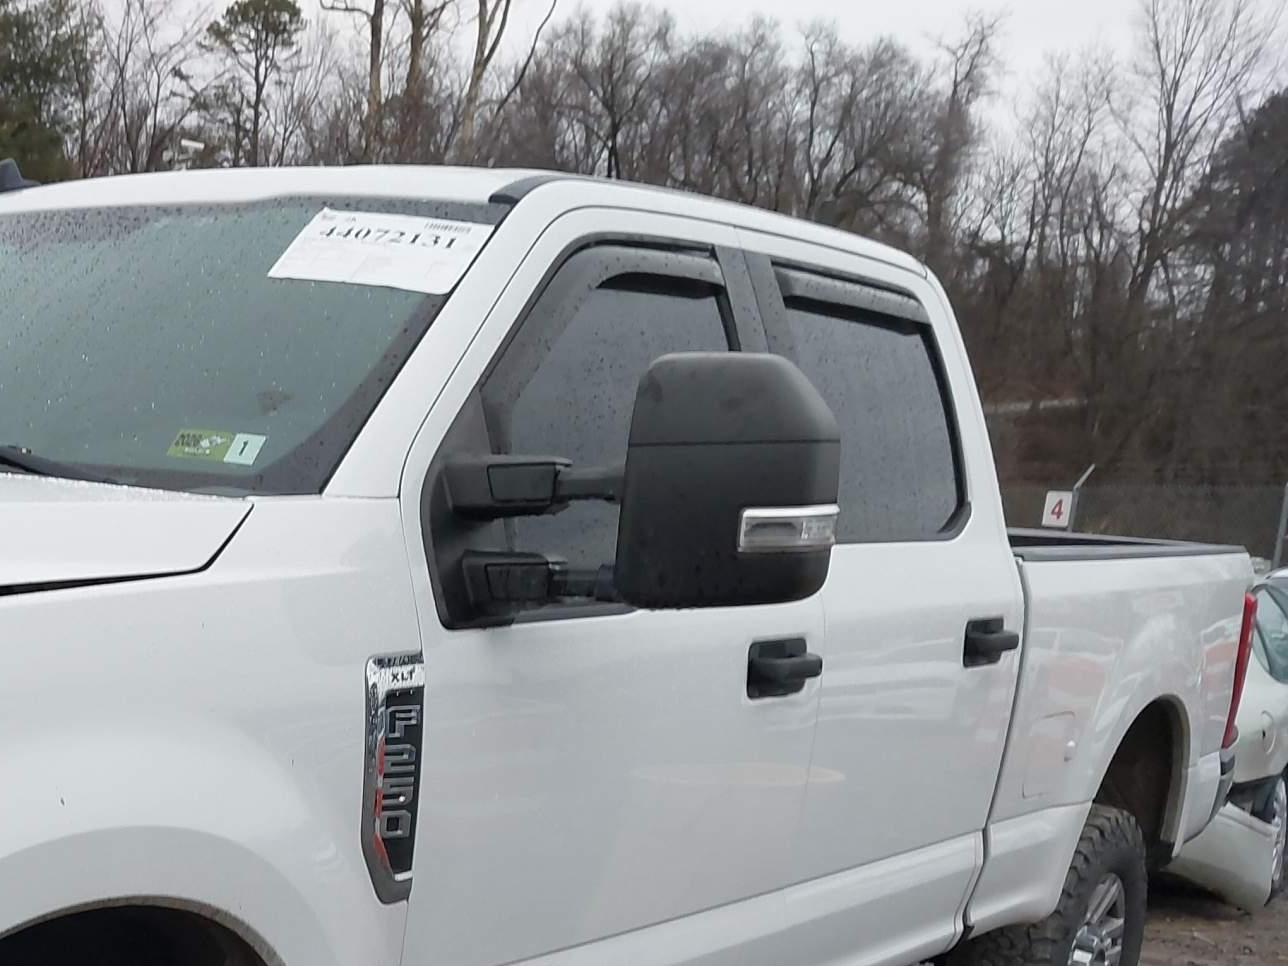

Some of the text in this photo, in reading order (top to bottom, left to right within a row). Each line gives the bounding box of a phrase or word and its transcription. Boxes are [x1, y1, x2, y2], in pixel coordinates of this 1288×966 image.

[319, 225, 458, 250] 44072131
[1050, 498, 1064, 520] 4
[391, 666, 416, 683] XLT
